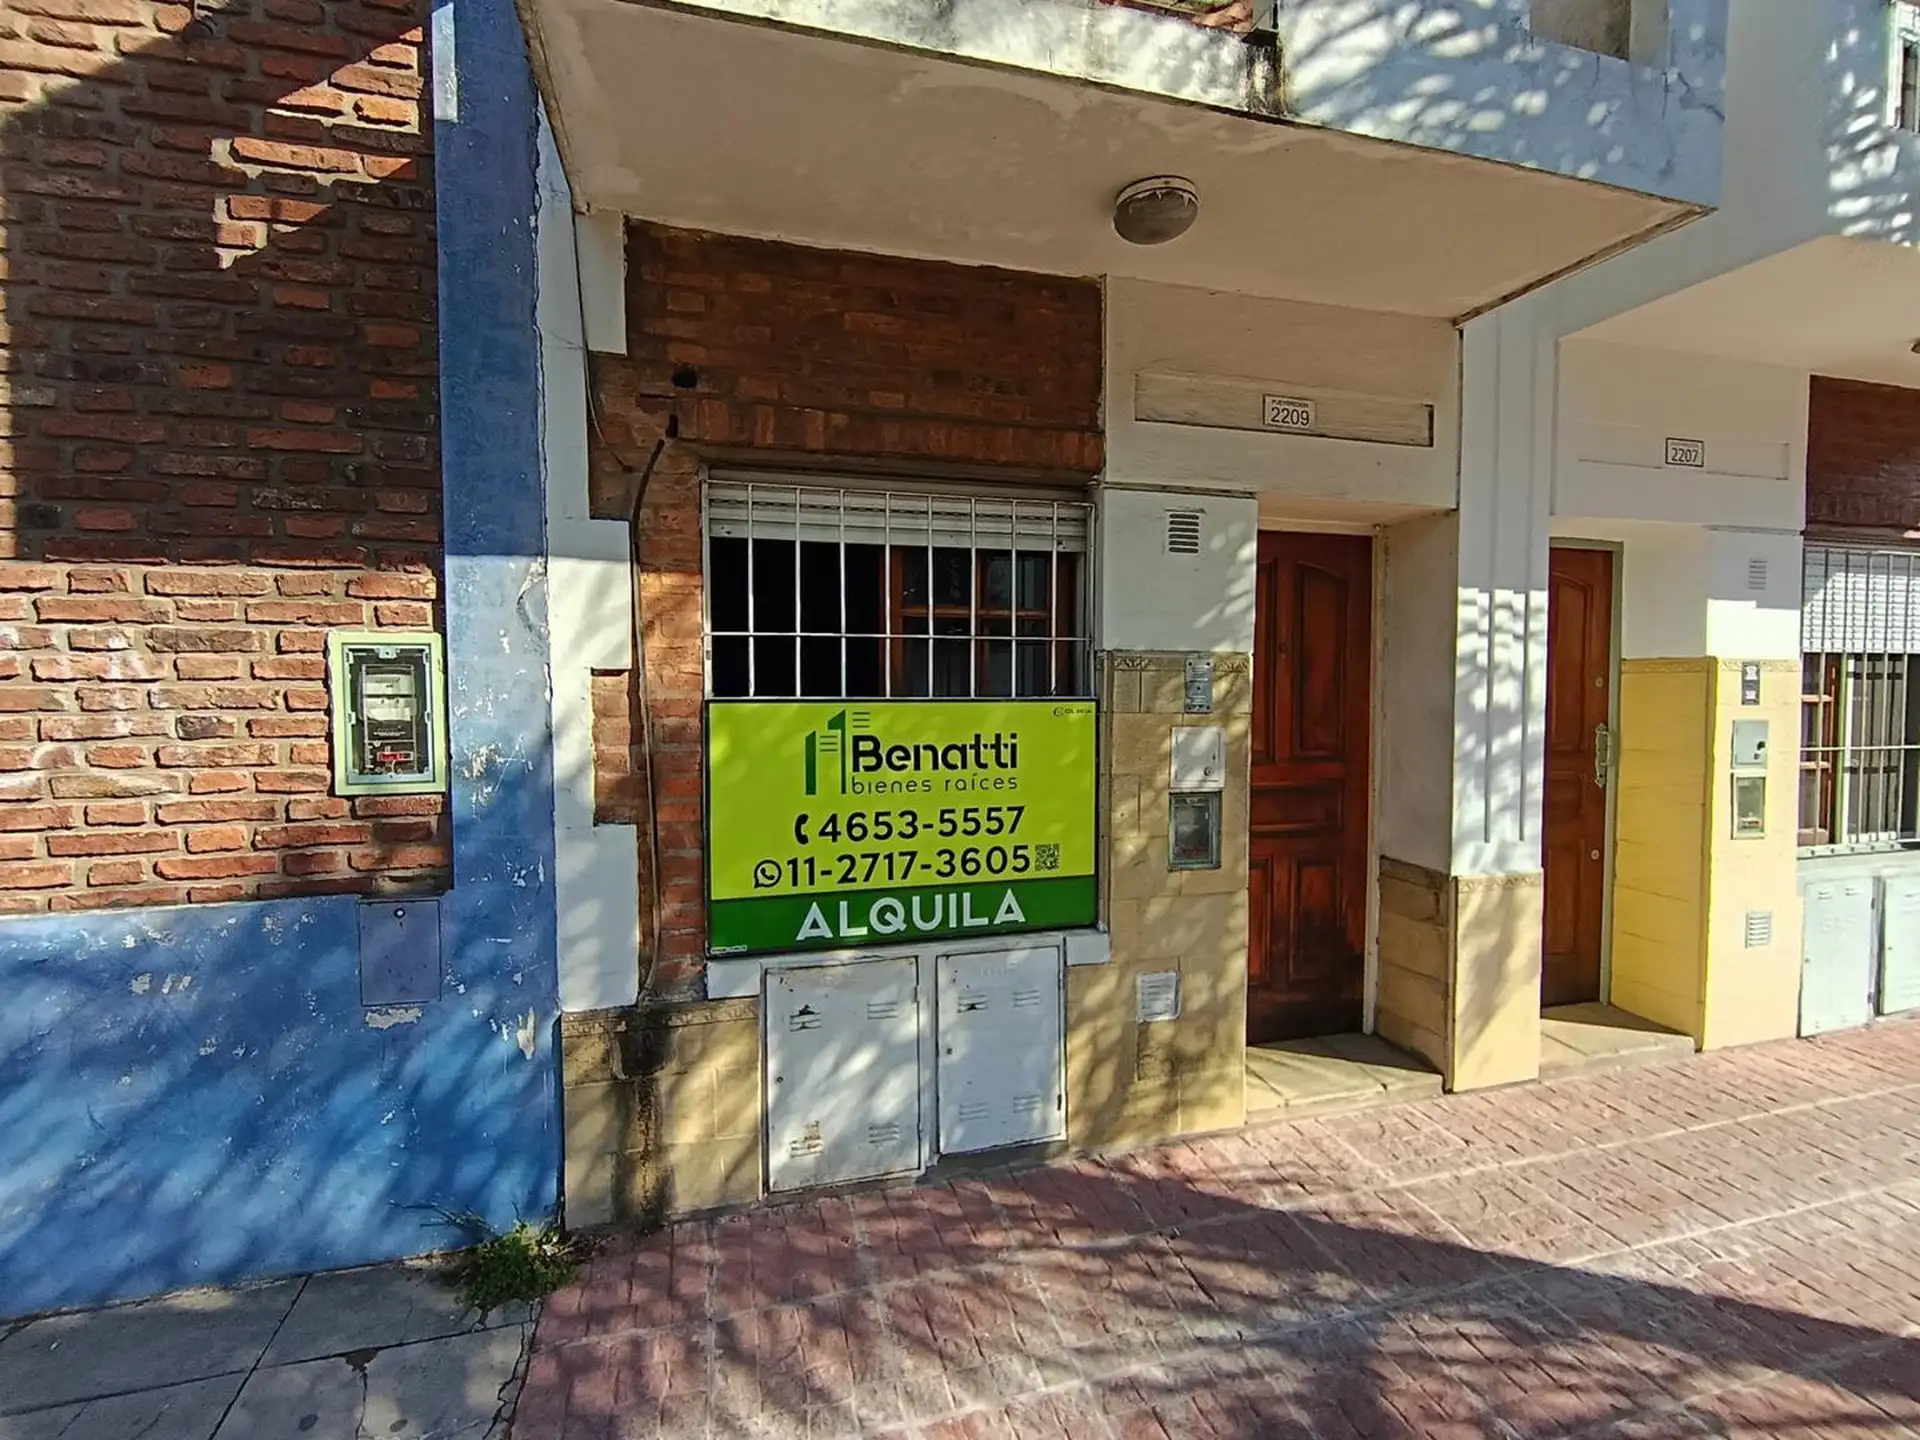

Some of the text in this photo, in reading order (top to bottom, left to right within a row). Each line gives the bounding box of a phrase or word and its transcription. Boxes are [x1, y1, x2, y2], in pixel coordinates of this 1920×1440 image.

[1271, 406, 1310, 426] 2209
[1671, 446, 1699, 463] 2207
[852, 733, 1018, 773] Benatti
[852, 773, 1018, 795] bienes raíces
[818, 805, 1025, 843] 4653-5557
[787, 844, 1030, 887] 11-2717-3605
[796, 887, 1027, 941] ALQUILA
